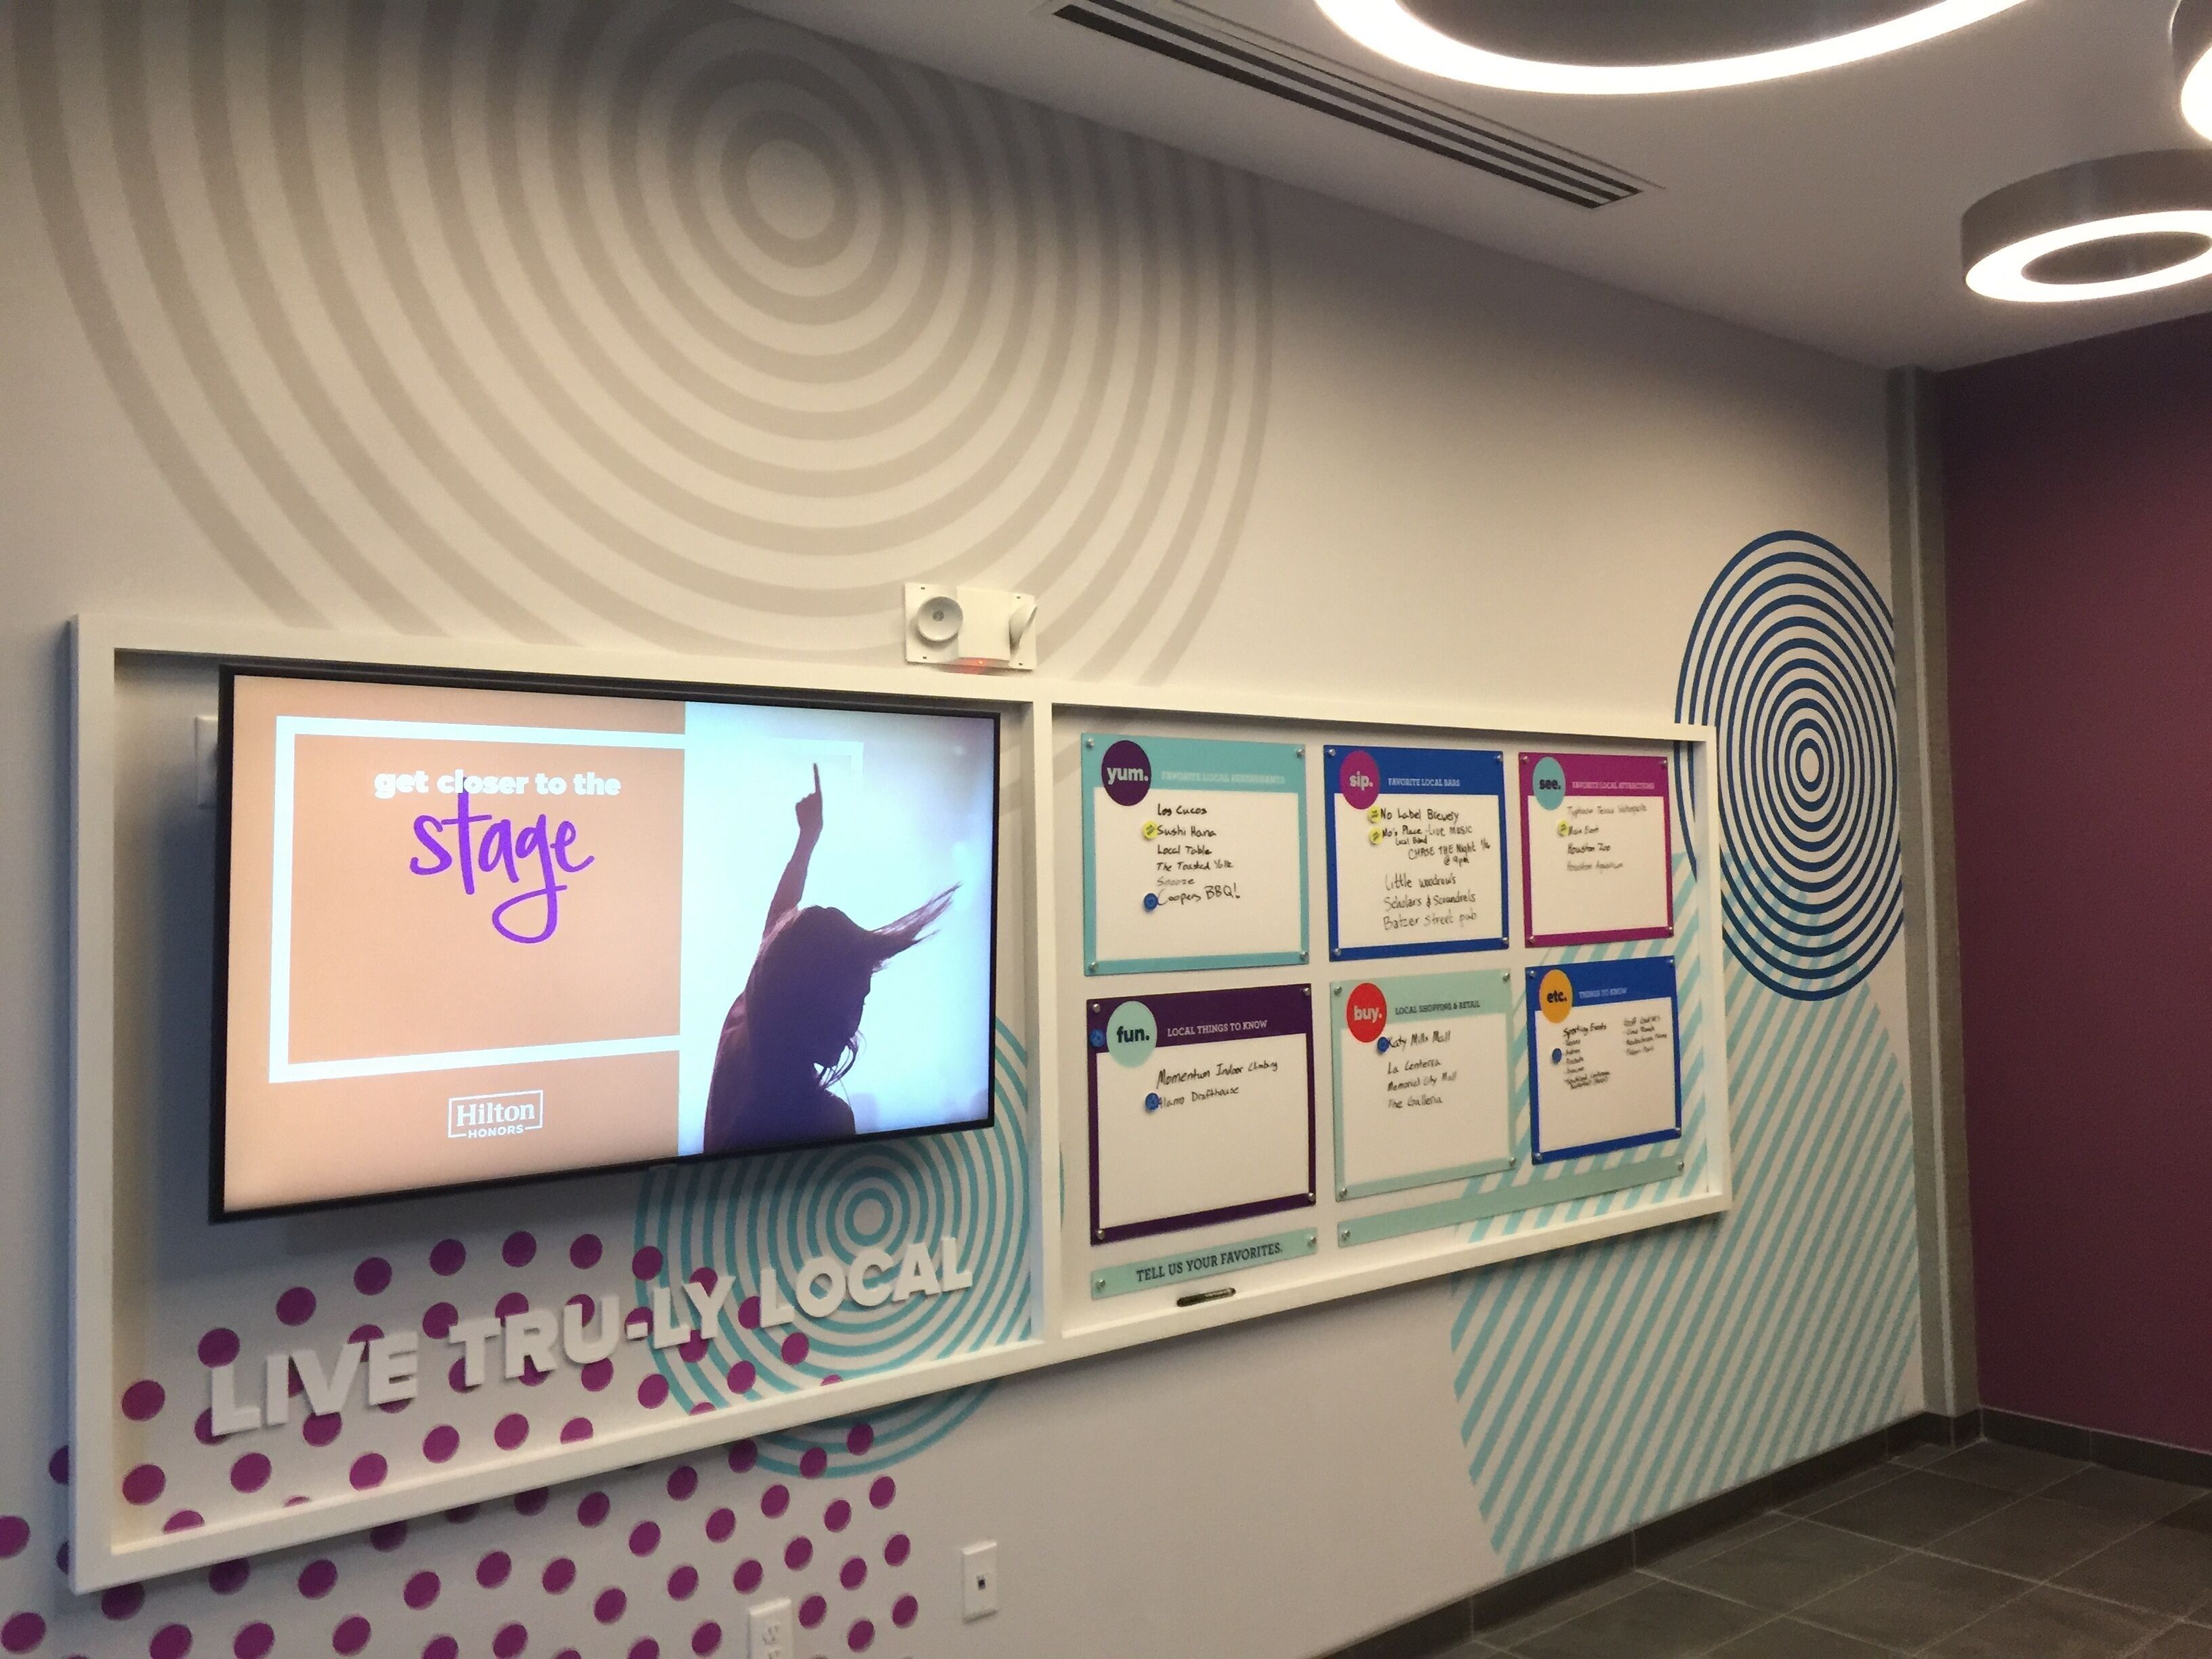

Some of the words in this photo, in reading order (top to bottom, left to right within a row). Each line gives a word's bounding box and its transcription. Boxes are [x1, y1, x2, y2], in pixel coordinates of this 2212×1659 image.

[1107, 766, 1149, 785] yum.
[1349, 771, 1373, 791] sip.
[1388, 777, 1420, 786] FAVORITE
[1421, 779, 1443, 787] LOCAL
[1444, 779, 1460, 787] BARS
[374, 771, 429, 799] get
[436, 769, 529, 794] closer
[535, 773, 567, 794] to
[573, 772, 621, 796] the
[1540, 779, 1561, 790] see.
[1176, 805, 1208, 815] Cucos
[1380, 808, 1393, 820] No
[1397, 808, 1422, 821] Label
[1157, 825, 1186, 836] Sushi
[1401, 825, 1422, 835] Place
[1158, 844, 1181, 855] Local
[1185, 844, 1212, 855] Table
[1408, 847, 1435, 860] CHASE
[1438, 844, 1454, 855] THE
[1568, 842, 1595, 855] Houston
[1597, 842, 1612, 852] Zoo
[409, 777, 595, 943] stage
[1156, 862, 1172, 872] The
[1157, 876, 1195, 886] Snooze
[1385, 872, 1413, 890] Little
[1204, 882, 1241, 900] BBQ!
[1383, 894, 1422, 912] Scholars
[1433, 889, 1476, 906] Scoundrels
[1459, 907, 1477, 928] pub
[1547, 990, 1568, 1003] etc.
[1353, 1005, 1382, 1023] buy.
[1395, 1006, 1417, 1015] LOCAL
[1418, 1003, 1452, 1013] SHOPPING
[1458, 1000, 1480, 1009] RETAIL
[1116, 1025, 1150, 1043] fun.
[1167, 1026, 1195, 1037] LOCAL
[1197, 1023, 1229, 1034] THINGS
[1229, 1022, 1242, 1032] TO
[1243, 1019, 1268, 1030] KNOW
[1410, 1033, 1429, 1047] Mills
[1432, 1029, 1451, 1044] Mall
[1156, 1068, 1210, 1089] Momentum
[1215, 1063, 1244, 1076] Indoor
[1387, 1061, 1399, 1075] La
[1191, 1086, 1240, 1102] Drafthouse
[1388, 1098, 1403, 1109] The
[457, 1102, 535, 1127] Hilton
[468, 1124, 524, 1139] HONORS
[1136, 1266, 1166, 1282] TELL
[1168, 1261, 1183, 1276] US
[1185, 1255, 1218, 1272] YOUR
[1220, 1242, 1284, 1265] FAVORITES.
[209, 1330, 419, 1437] LIVE
[448, 1274, 735, 1388] TRU-LY
[758, 1235, 973, 1330] LOCAL
